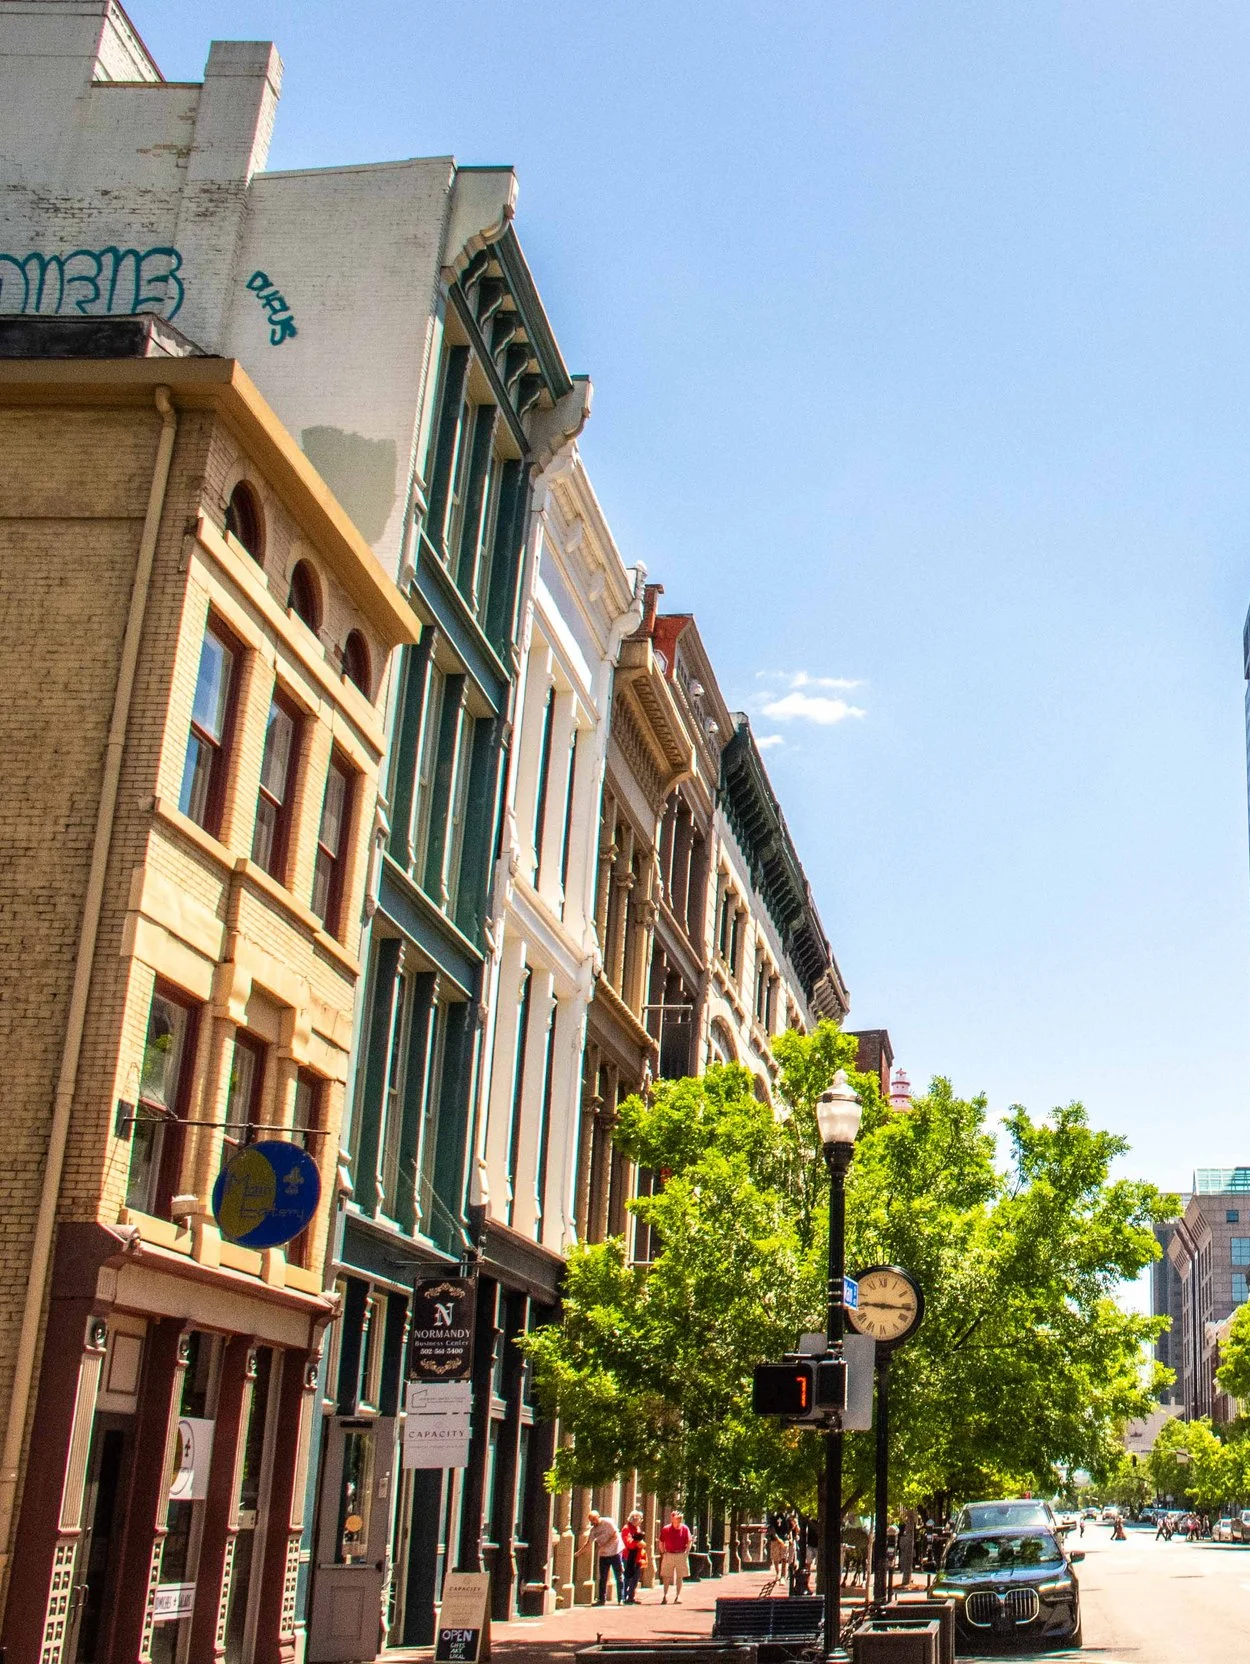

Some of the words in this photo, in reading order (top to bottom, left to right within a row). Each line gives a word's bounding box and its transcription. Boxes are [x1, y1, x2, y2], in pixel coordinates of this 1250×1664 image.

[433, 1302, 454, 1326] N
[414, 1329, 471, 1339] NORMANDY
[408, 1430, 465, 1439] CAPACITY
[442, 1629, 473, 1642] OPEN
